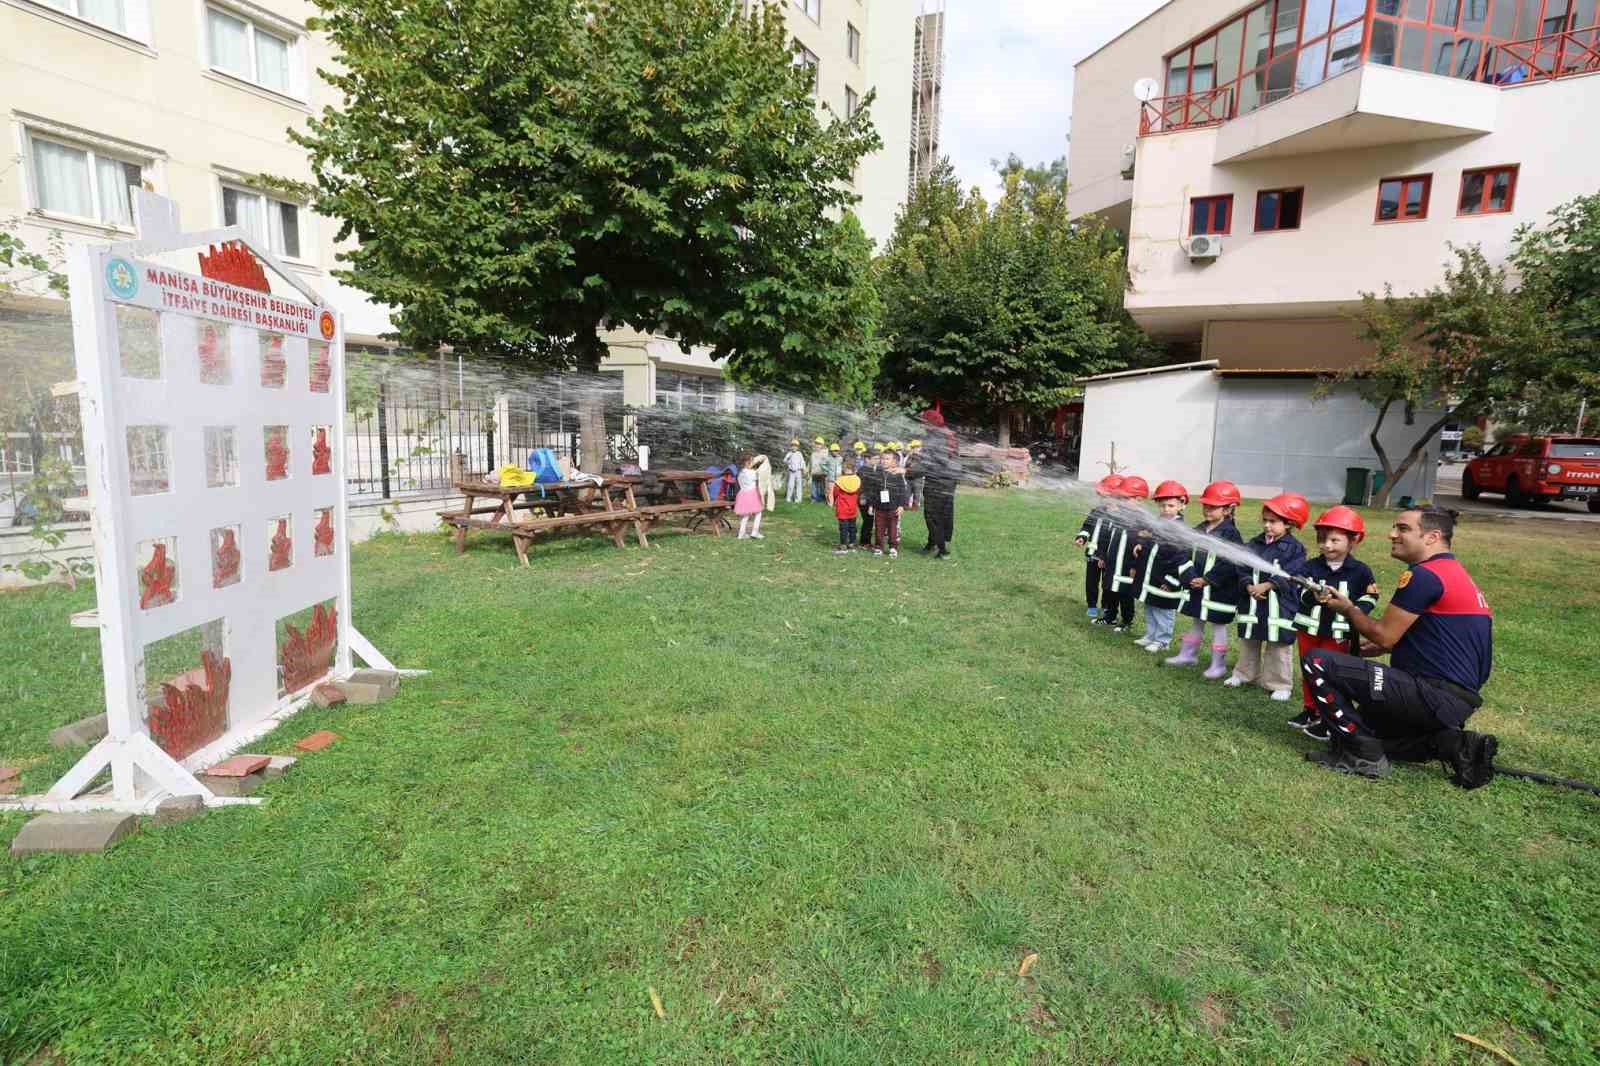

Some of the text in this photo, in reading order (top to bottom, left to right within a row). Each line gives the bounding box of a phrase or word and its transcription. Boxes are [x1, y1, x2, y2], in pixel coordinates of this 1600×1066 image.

[147, 268, 199, 294] MANİSA
[162, 287, 308, 335] İTFAİYE DAİRESİ BAŞKANLIĞI
